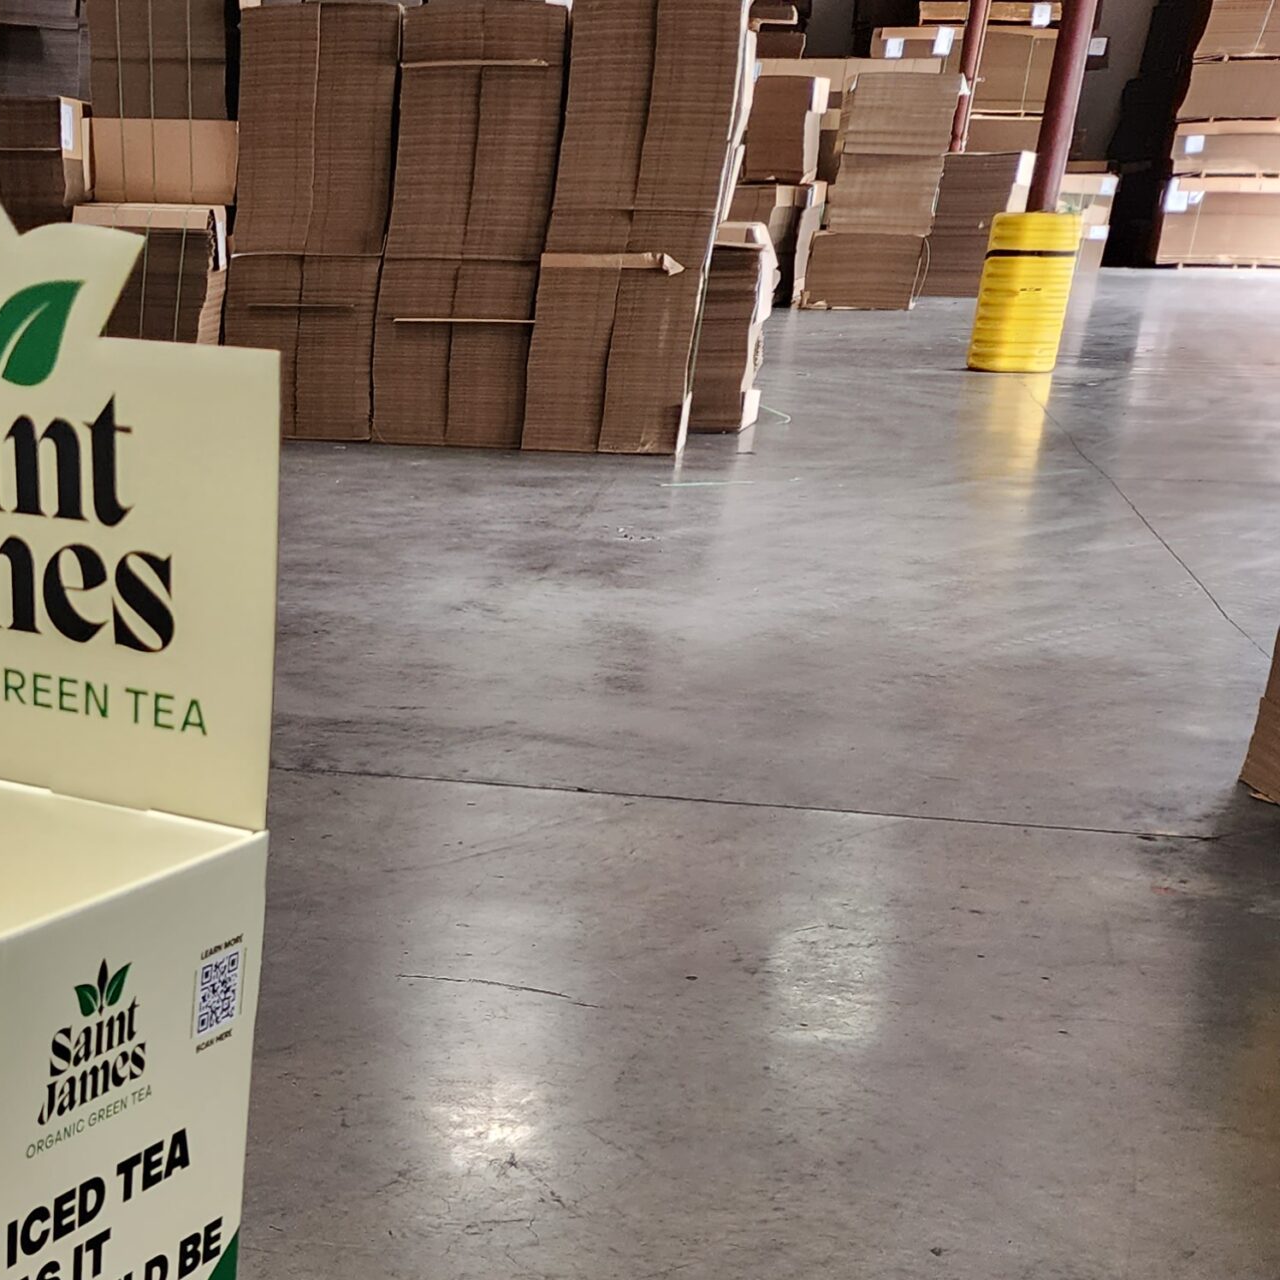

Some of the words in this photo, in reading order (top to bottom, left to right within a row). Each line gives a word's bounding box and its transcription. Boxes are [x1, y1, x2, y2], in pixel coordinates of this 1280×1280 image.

[124, 687, 208, 736] TEA
[49, 996, 140, 1077] Saint
[26, 1119, 84, 1159] ORGANIC
[87, 1099, 128, 1128] GREEN
[130, 1085, 152, 1105] TEA
[37, 1042, 146, 1126] James
[7, 1176, 106, 1269] ICED
[116, 1127, 190, 1203] TEA
[178, 1216, 223, 1280] BE
